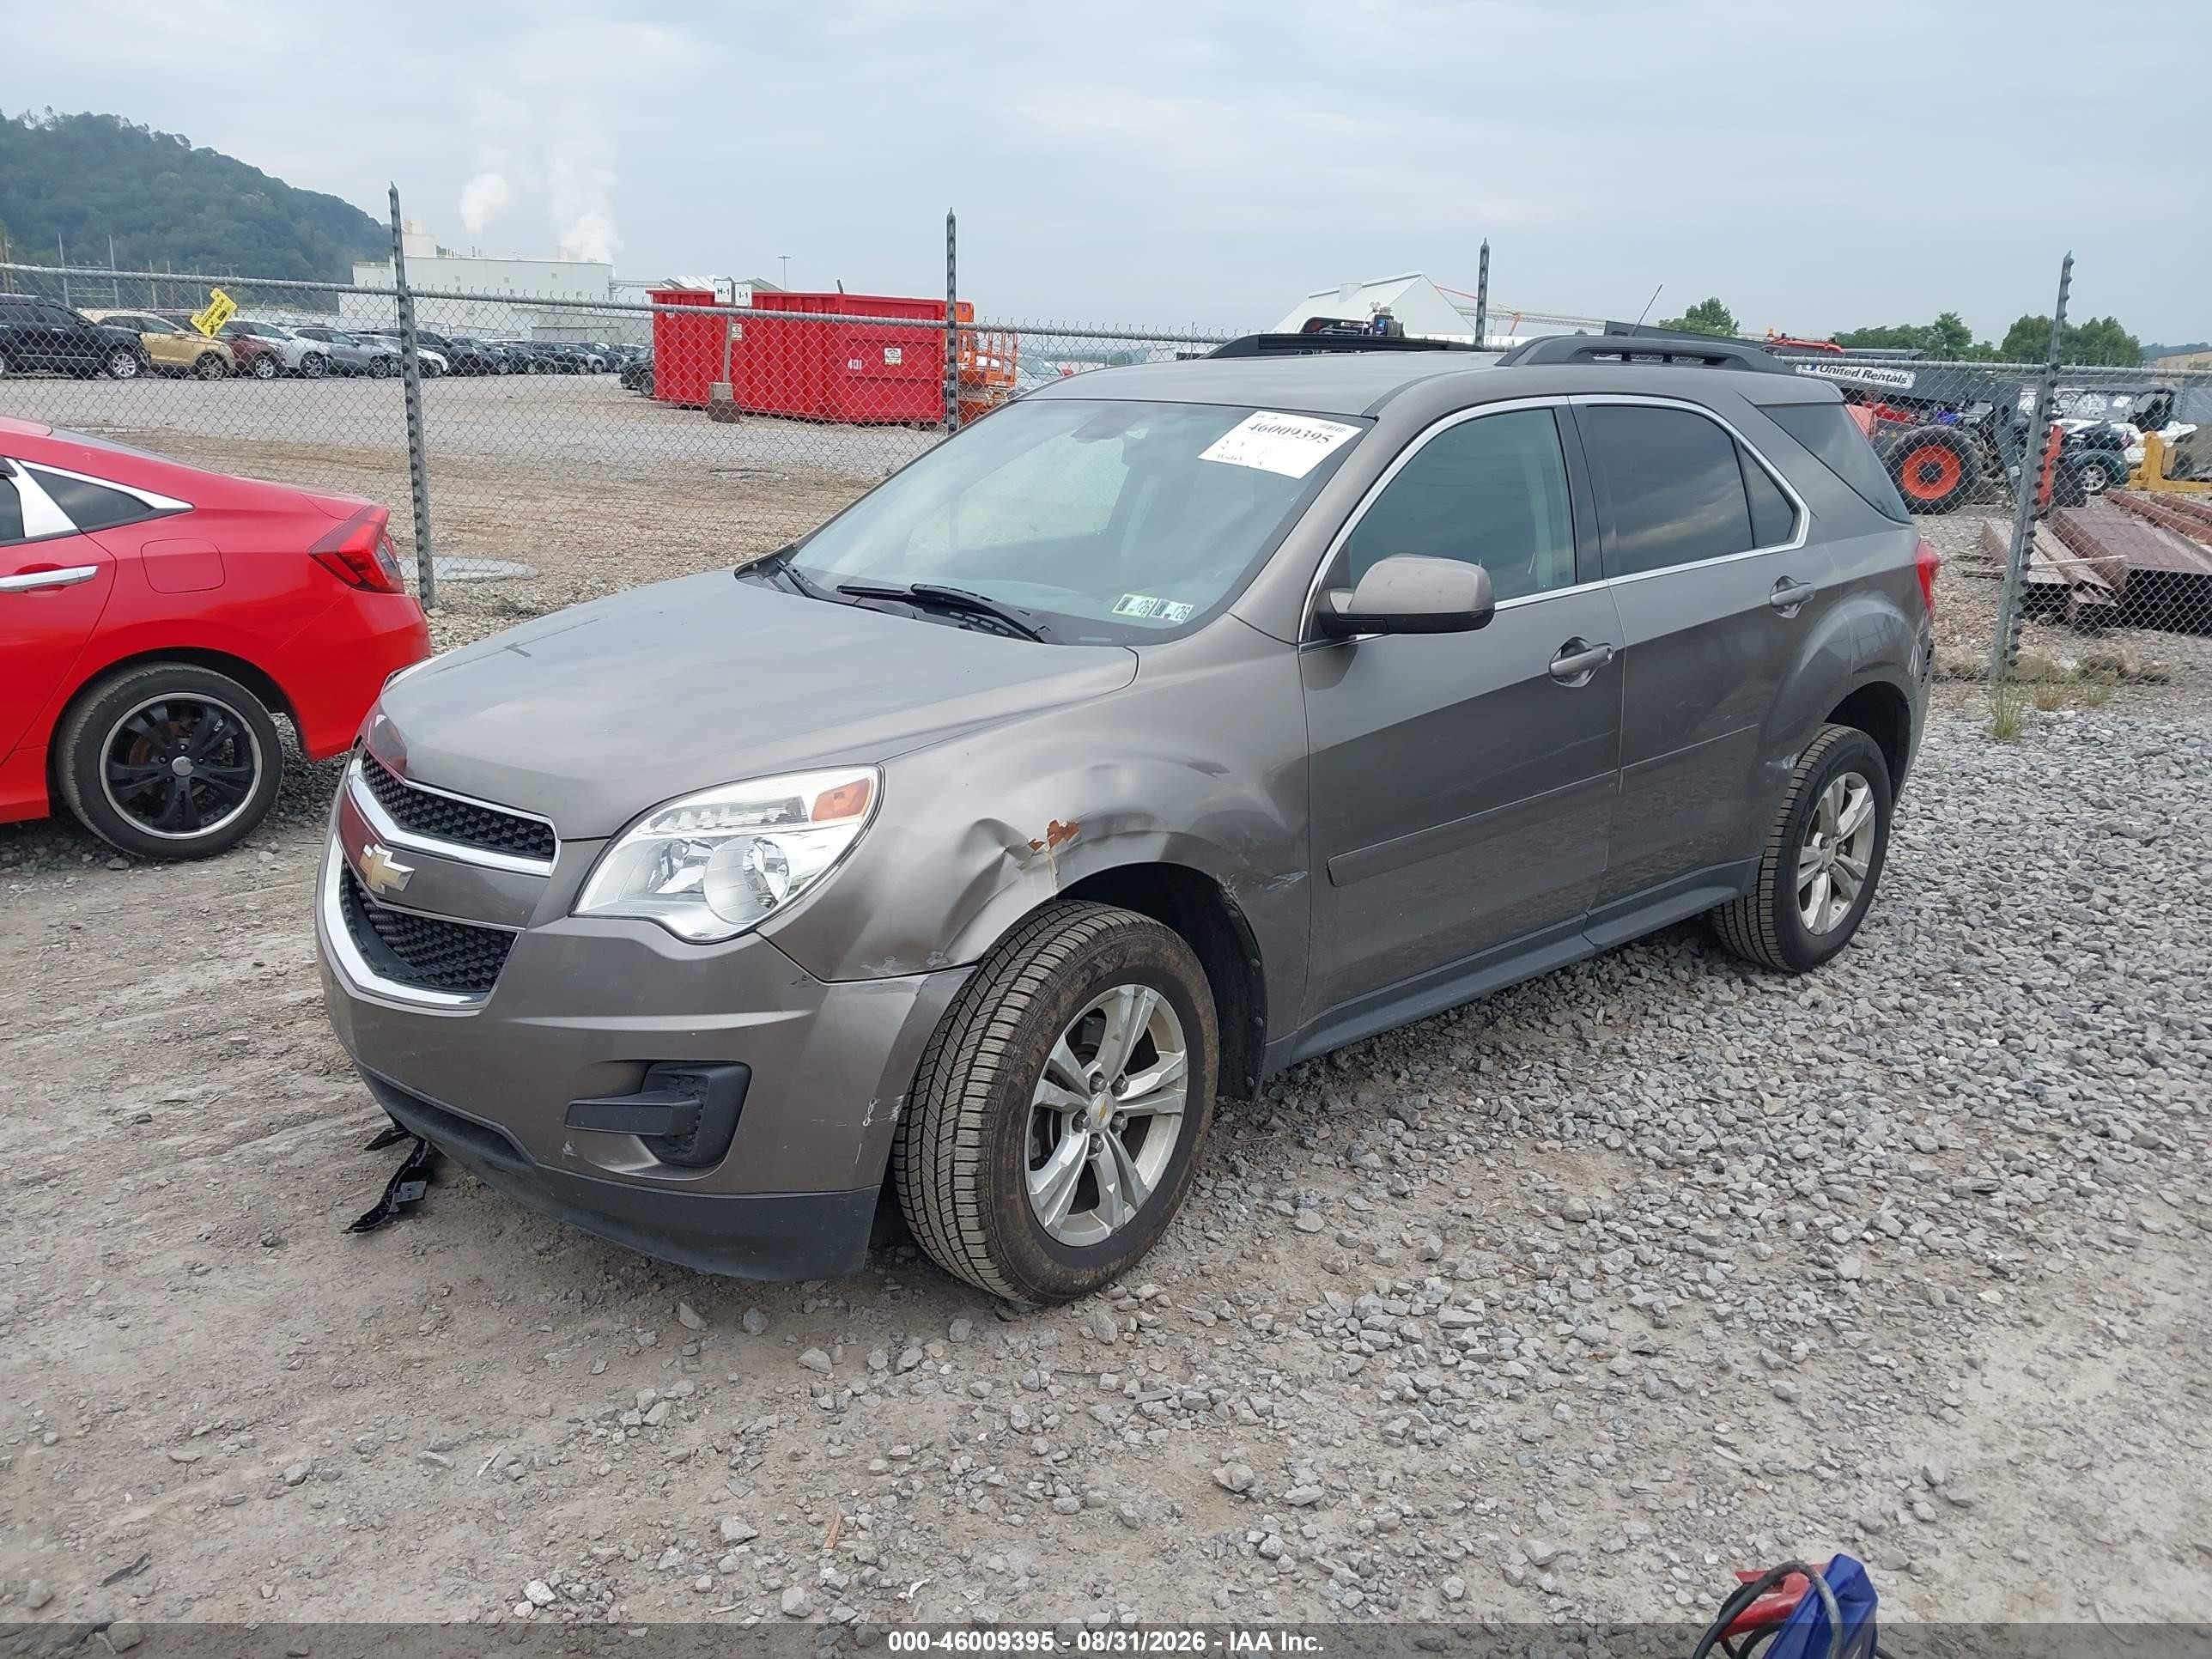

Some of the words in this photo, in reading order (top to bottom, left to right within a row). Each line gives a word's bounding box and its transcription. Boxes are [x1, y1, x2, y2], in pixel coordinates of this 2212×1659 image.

[717, 287, 730, 295] H-1
[847, 359, 862, 370] 401
[1820, 363, 1860, 378] United
[1862, 369, 1908, 385] Rentals
[1248, 422, 1336, 445] 46009395
